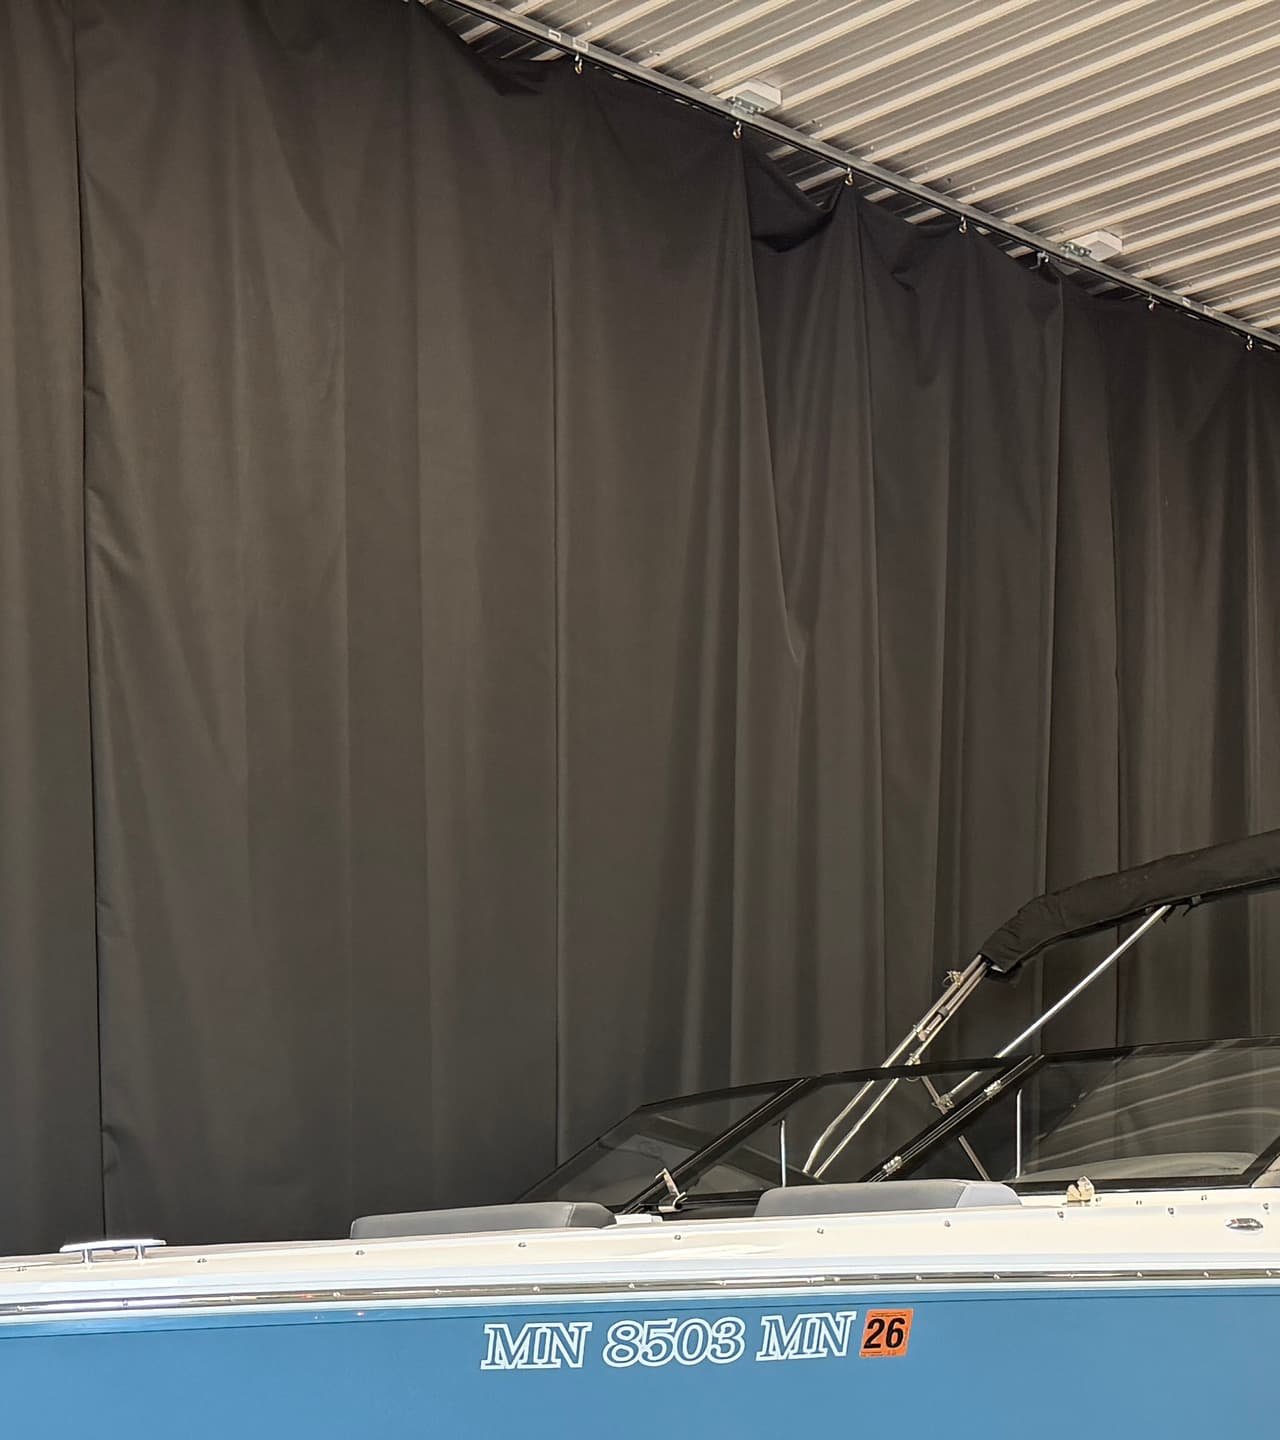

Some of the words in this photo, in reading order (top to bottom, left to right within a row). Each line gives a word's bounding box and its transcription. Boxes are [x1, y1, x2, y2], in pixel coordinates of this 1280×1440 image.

[480, 1322, 592, 1370] MN
[601, 1316, 746, 1368] 8503
[755, 1311, 856, 1361] MN
[863, 1317, 906, 1349] 26
